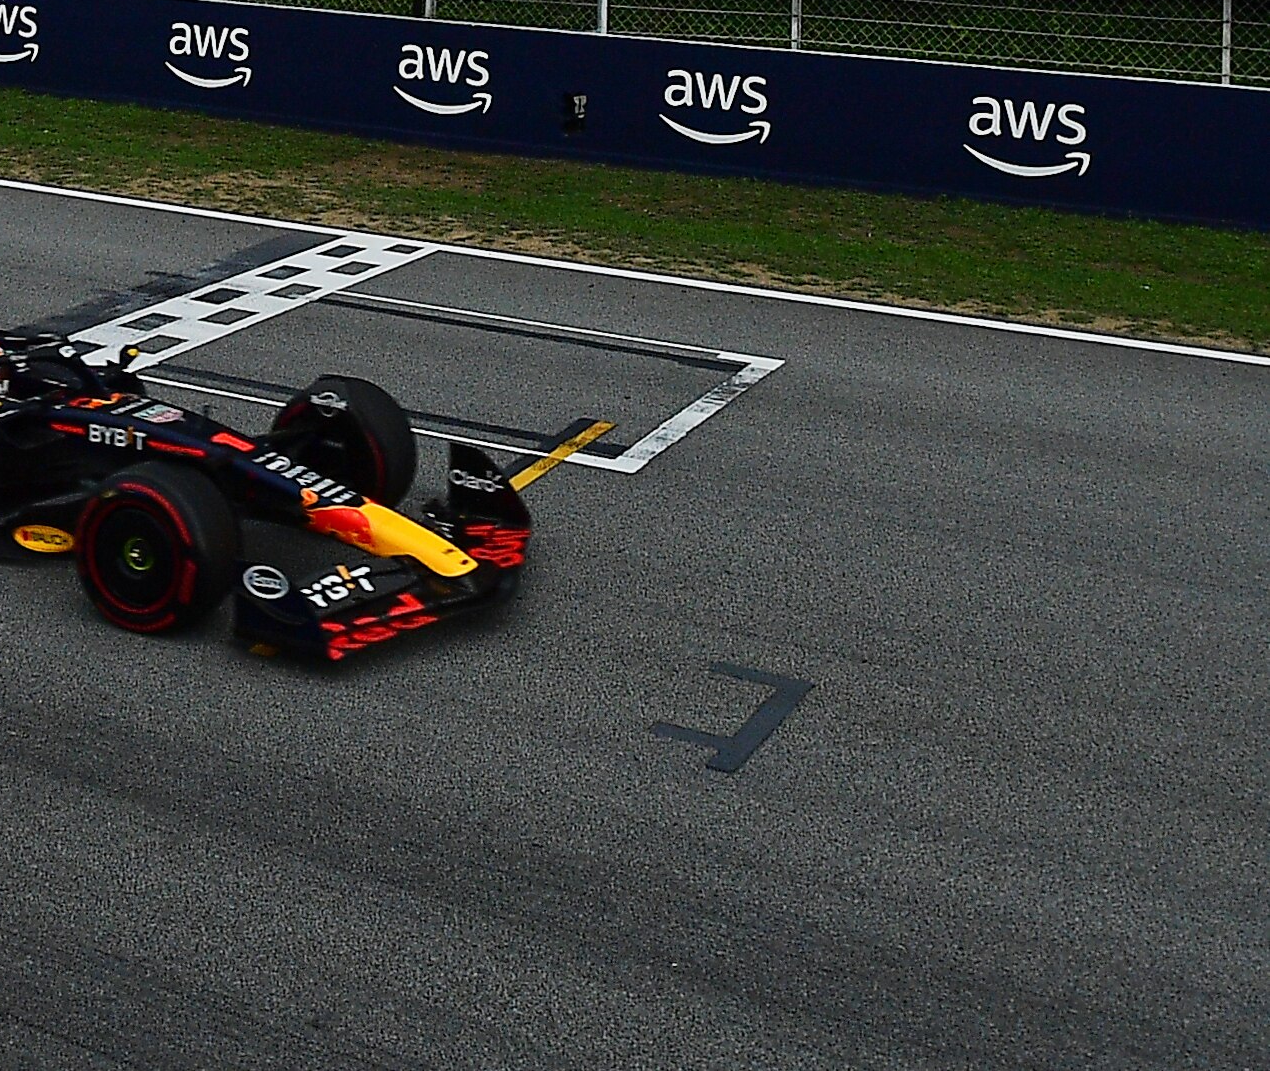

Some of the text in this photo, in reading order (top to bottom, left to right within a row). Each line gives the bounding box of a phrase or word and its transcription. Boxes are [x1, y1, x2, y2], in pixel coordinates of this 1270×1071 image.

[170, 22, 249, 61] aws
[399, 44, 489, 87] aws
[665, 69, 768, 115] aws
[969, 96, 1087, 145] aws
